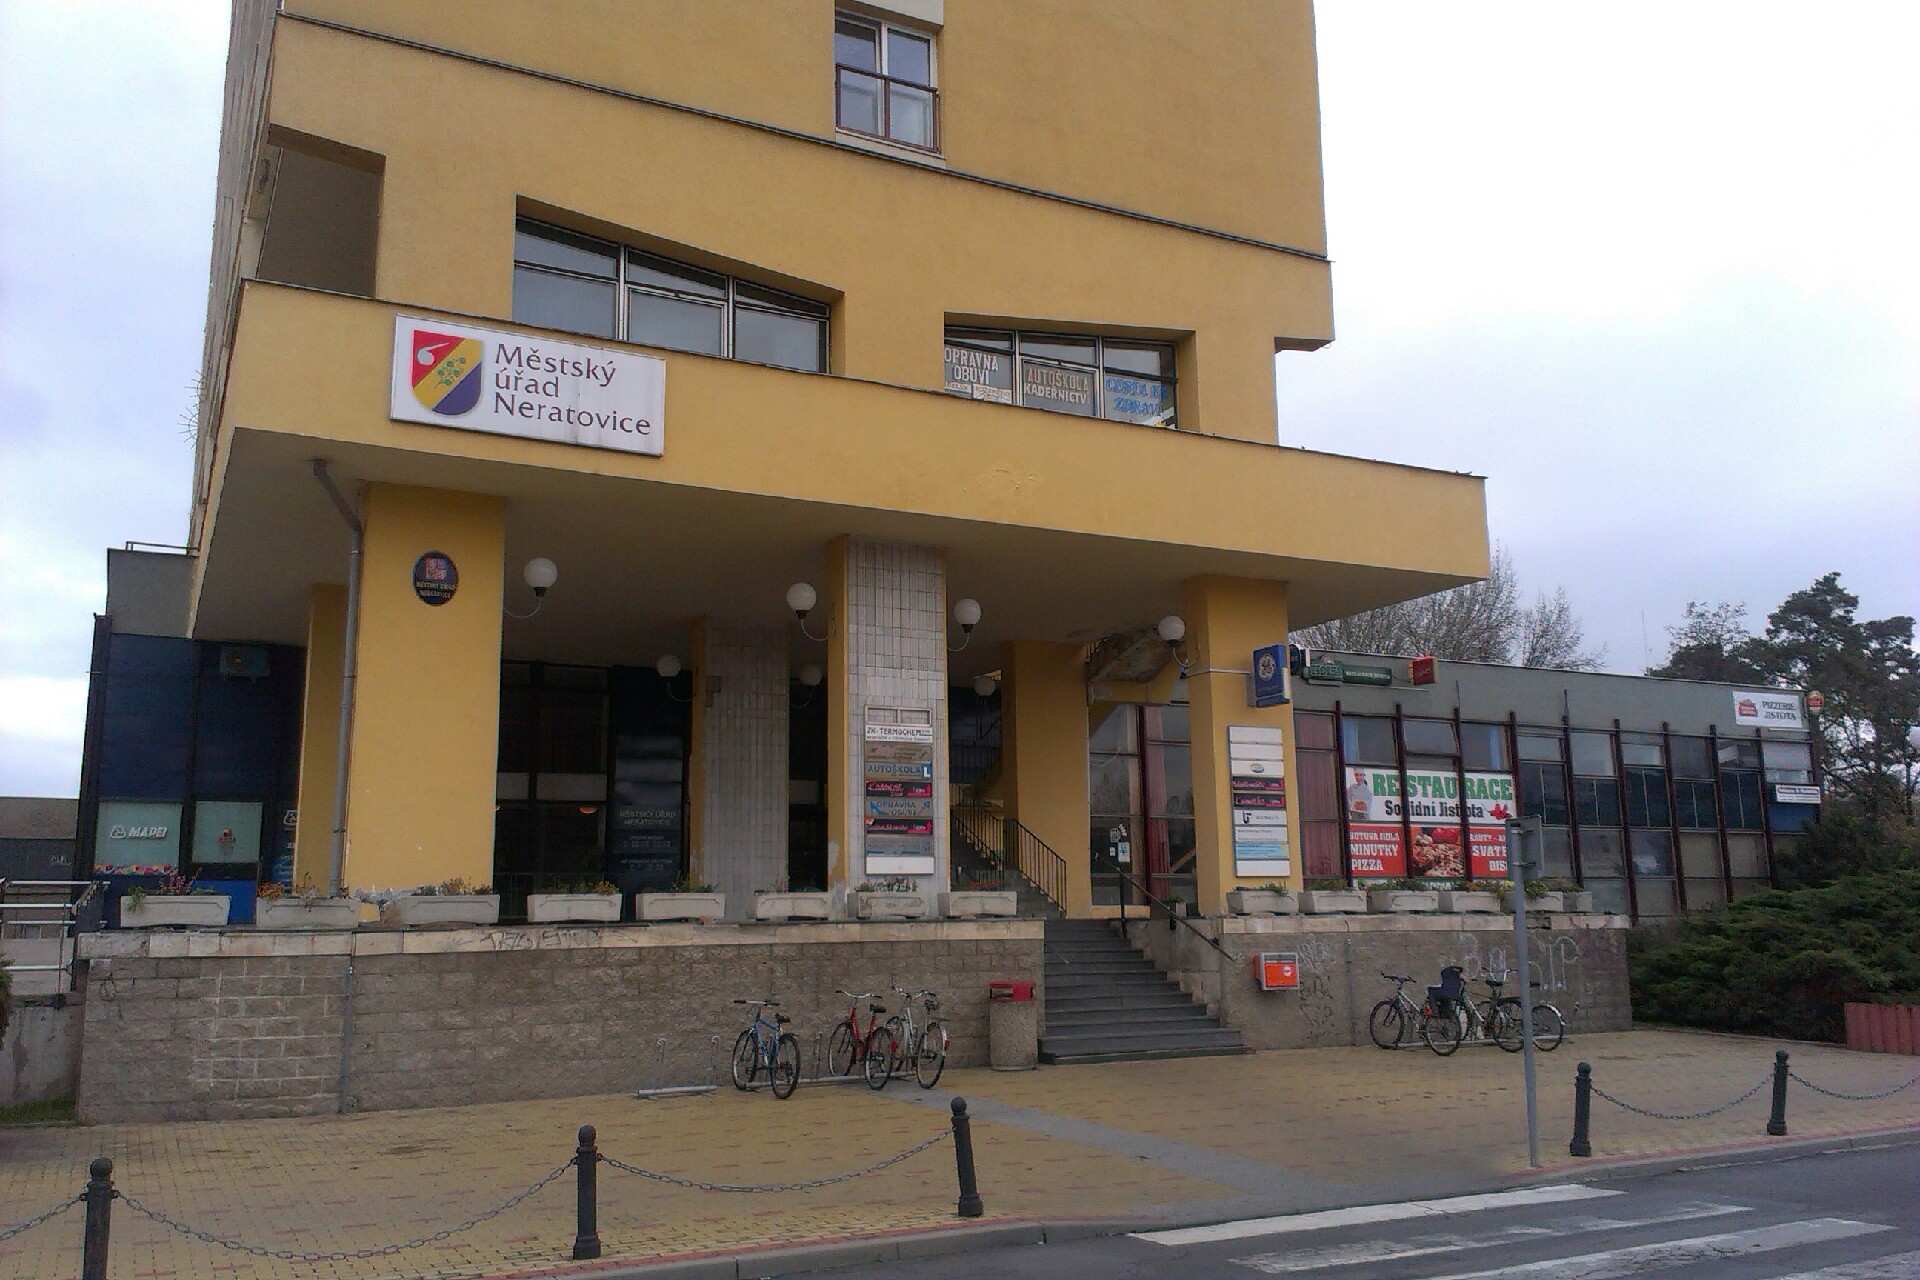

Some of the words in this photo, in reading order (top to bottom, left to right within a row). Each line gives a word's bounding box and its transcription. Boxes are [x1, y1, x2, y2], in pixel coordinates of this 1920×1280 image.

[495, 343, 616, 387] Městský
[945, 347, 999, 371] OPRAVNA
[495, 367, 559, 397] úřad
[954, 365, 990, 385] OBUVI
[1027, 367, 1089, 391] AUTOŠKOLA
[494, 392, 651, 436] Neratovice
[868, 763, 921, 774] AUTOŠKOLA
[1372, 773, 1513, 801] RESTAURACE
[1385, 799, 1437, 817] Soidní
[128, 826, 168, 838] MAPEI
[1350, 843, 1399, 857] MINUTKY
[1352, 858, 1384, 871] PIZZA
[1489, 860, 1508, 871] DIS
